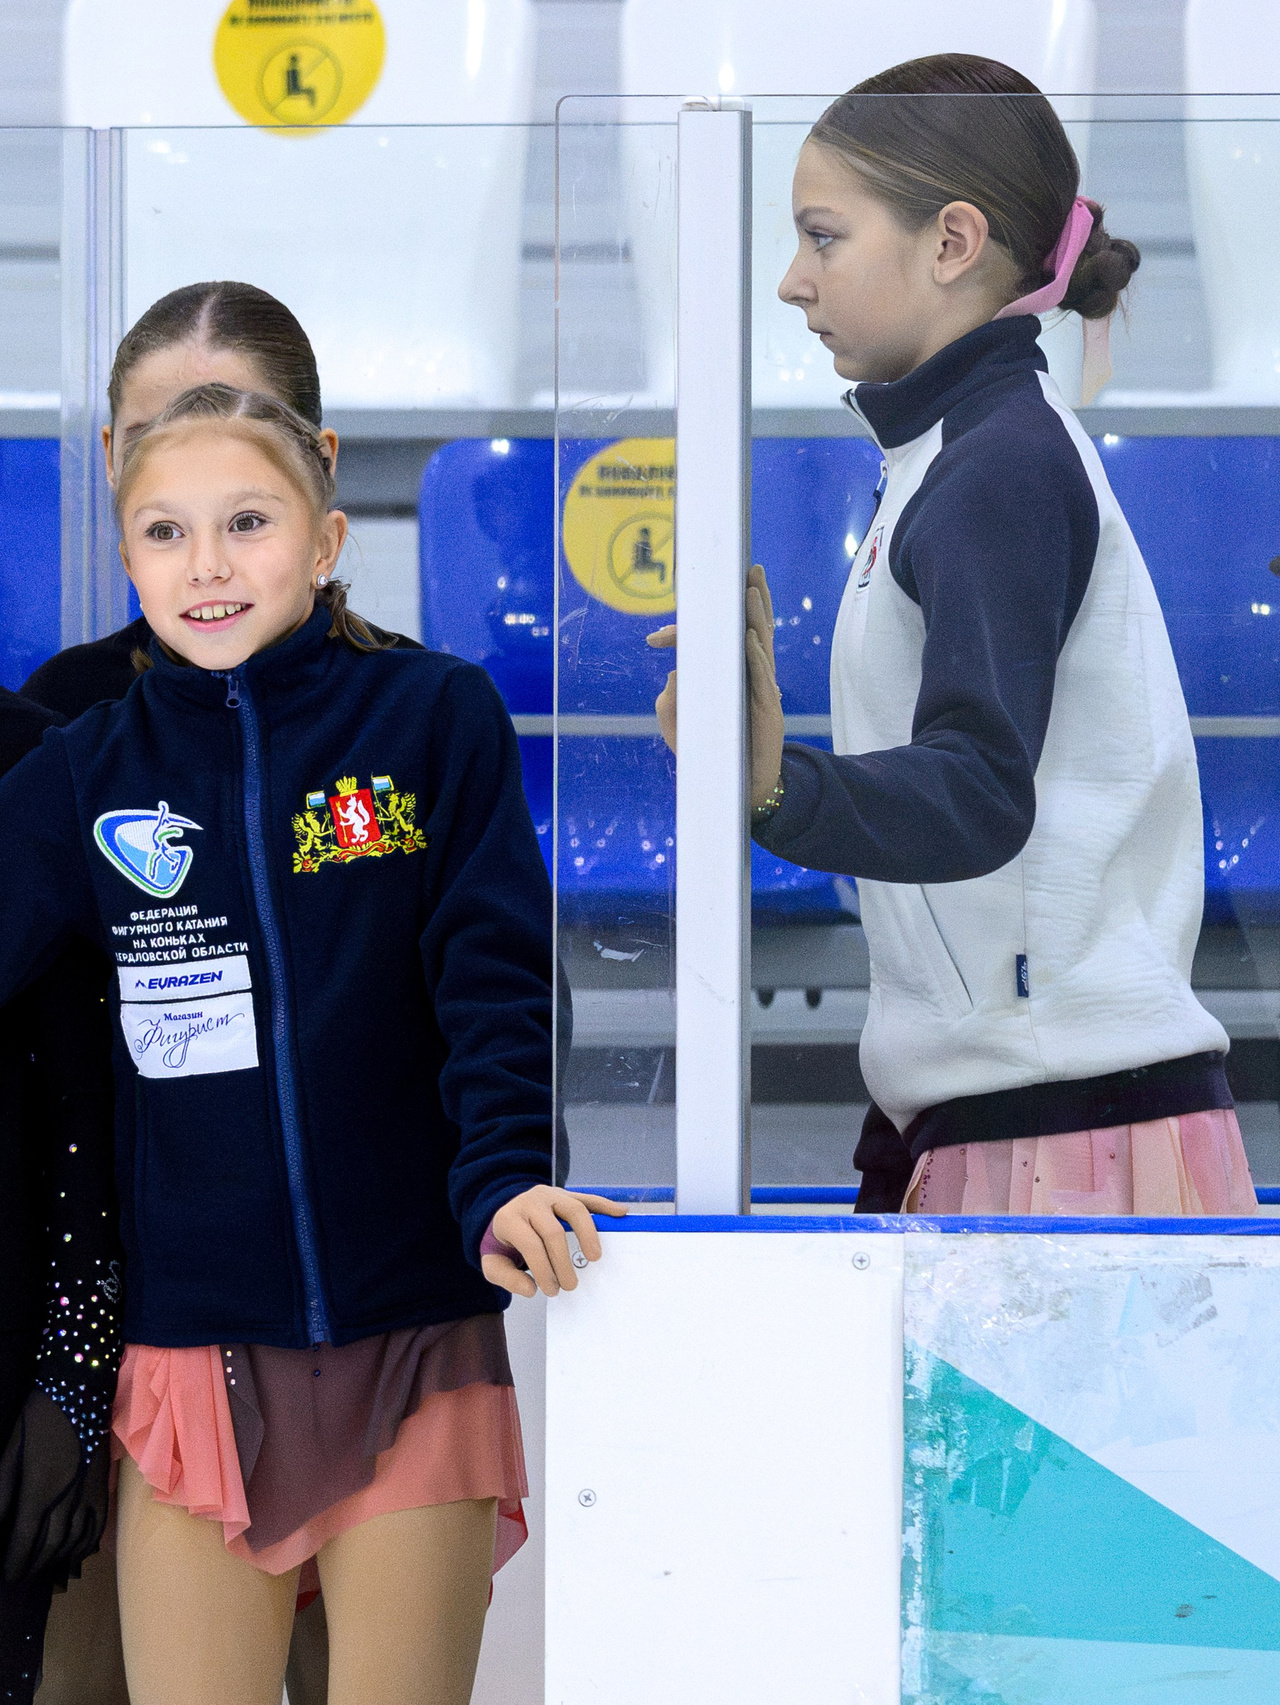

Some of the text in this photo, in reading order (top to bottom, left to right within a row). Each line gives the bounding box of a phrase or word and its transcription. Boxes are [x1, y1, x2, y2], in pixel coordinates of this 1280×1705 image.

[130, 905, 198, 921] ФЕДЕРАЦИЯ
[176, 916, 228, 932] КАТАНИЯ
[132, 933, 206, 949] НА КОНЬКАХ
[115, 942, 249, 963] ЕРДЛОВСКОЙ ОБЛАСТИ
[163, 1011, 203, 1021] Магазин
[134, 1013, 245, 1068] Фигурист
